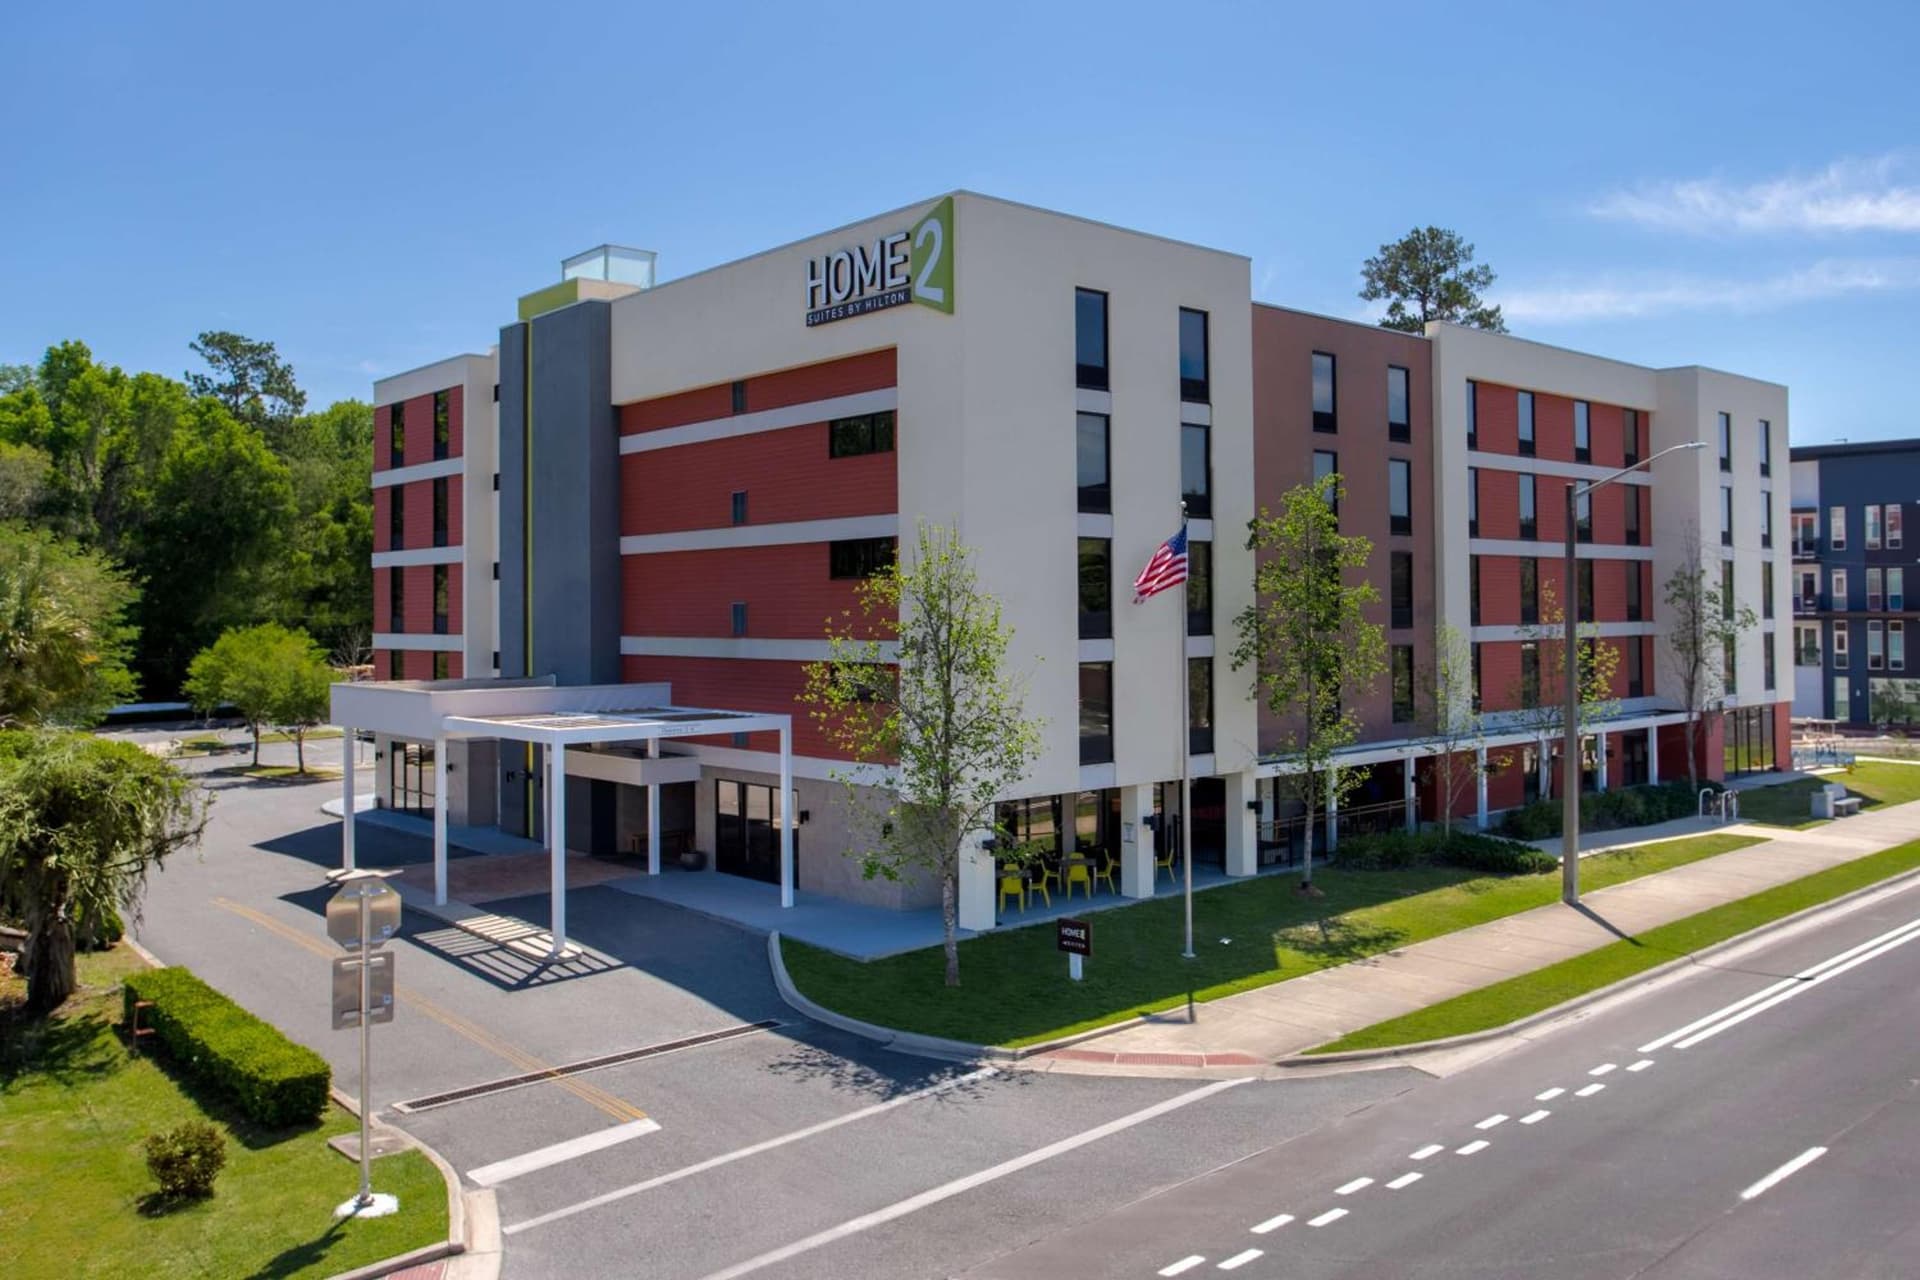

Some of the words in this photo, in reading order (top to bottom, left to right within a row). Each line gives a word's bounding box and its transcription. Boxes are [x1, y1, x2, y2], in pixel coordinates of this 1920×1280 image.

[806, 231, 910, 309] HOME
[914, 218, 944, 303] 2
[807, 307, 844, 325] SUITES
[848, 303, 861, 315] BY
[865, 292, 906, 310] HILTON
